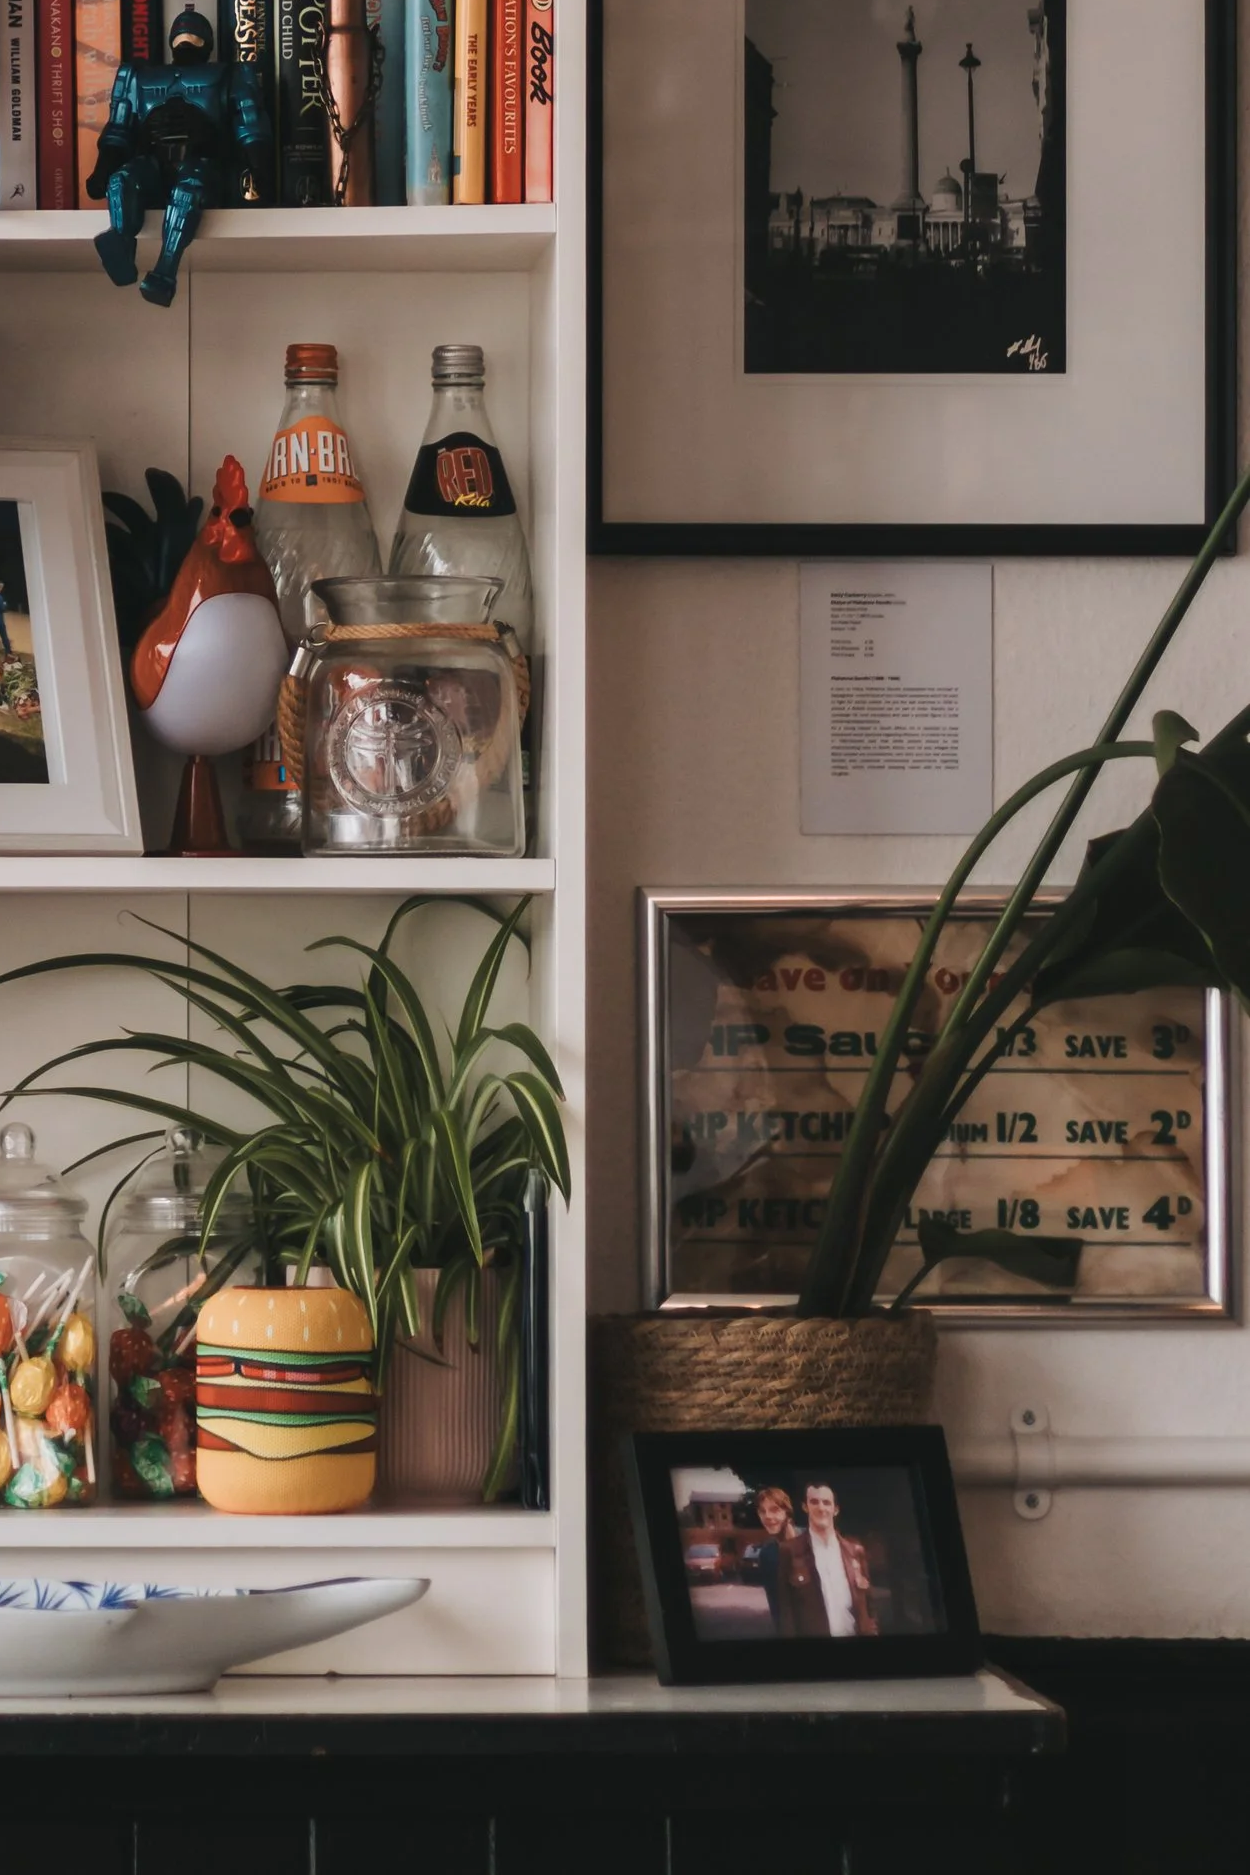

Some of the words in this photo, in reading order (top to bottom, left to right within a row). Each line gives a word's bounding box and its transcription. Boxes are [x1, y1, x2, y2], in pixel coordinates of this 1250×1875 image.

[282, 8, 293, 61] CHILD
[467, 33, 478, 55] THE
[10, 37, 21, 85] WILLIAM
[467, 58, 478, 93] EARLY
[530, 21, 554, 106] Book
[51, 63, 63, 106] THRIFT
[10, 88, 23, 142] GOLDMAN
[466, 93, 477, 128] YEARS
[504, 60, 518, 155] FAVOURITES
[52, 109, 64, 147] SHOP
[436, 447, 493, 503] RED
[755, 967, 827, 992] ave
[1064, 1035, 1127, 1058] SAVE
[996, 1112, 1038, 1143] 1/2
[1065, 1120, 1129, 1145] SAVE
[996, 1198, 1040, 1230] 1/8
[1066, 1206, 1130, 1230] SAVE
